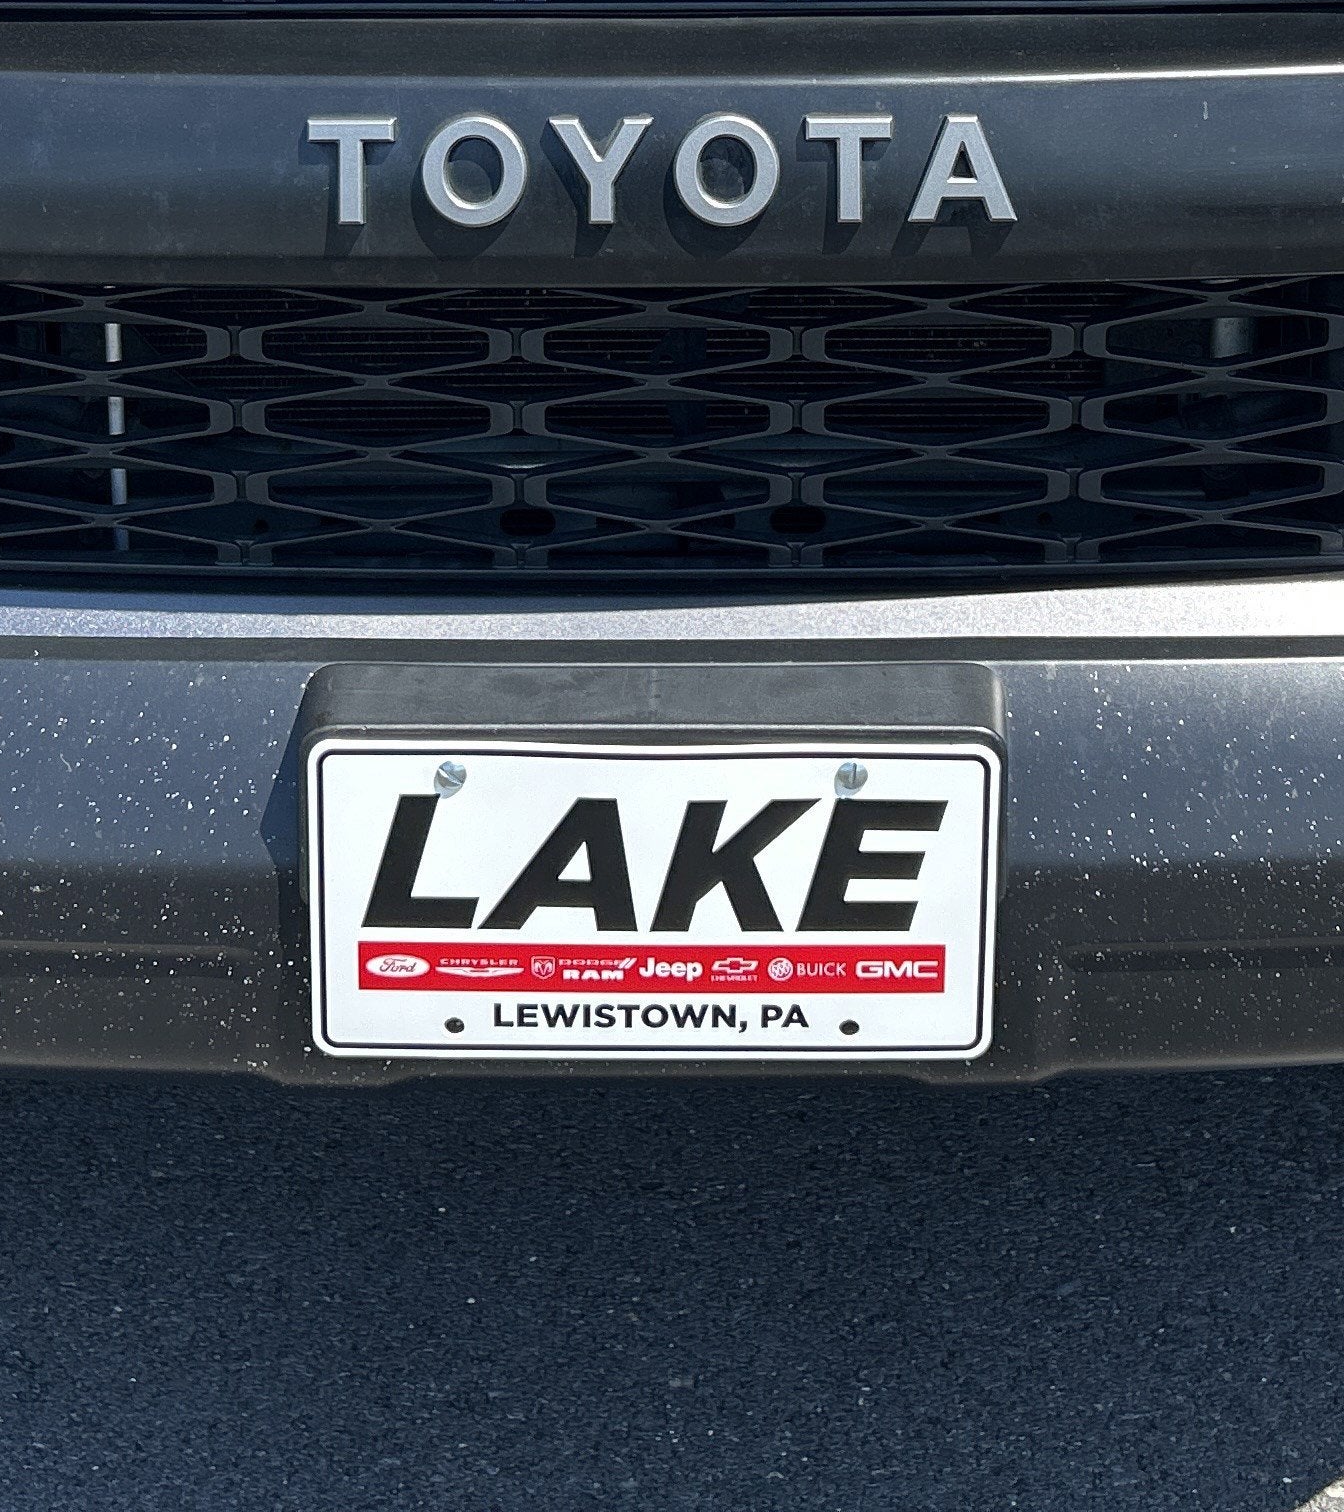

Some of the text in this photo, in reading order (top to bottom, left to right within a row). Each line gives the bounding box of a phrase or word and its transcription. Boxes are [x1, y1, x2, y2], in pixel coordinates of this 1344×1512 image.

[307, 115, 1017, 228] TOYOTA
[362, 794, 948, 932] LAKE
[439, 957, 519, 967] CHRYSLER
[639, 957, 703, 982] Jeep
[796, 962, 847, 977] BUICK
[856, 960, 939, 978] GMC
[562, 969, 625, 980] RAM
[493, 1002, 809, 1033] LEWISTOWN, PA
